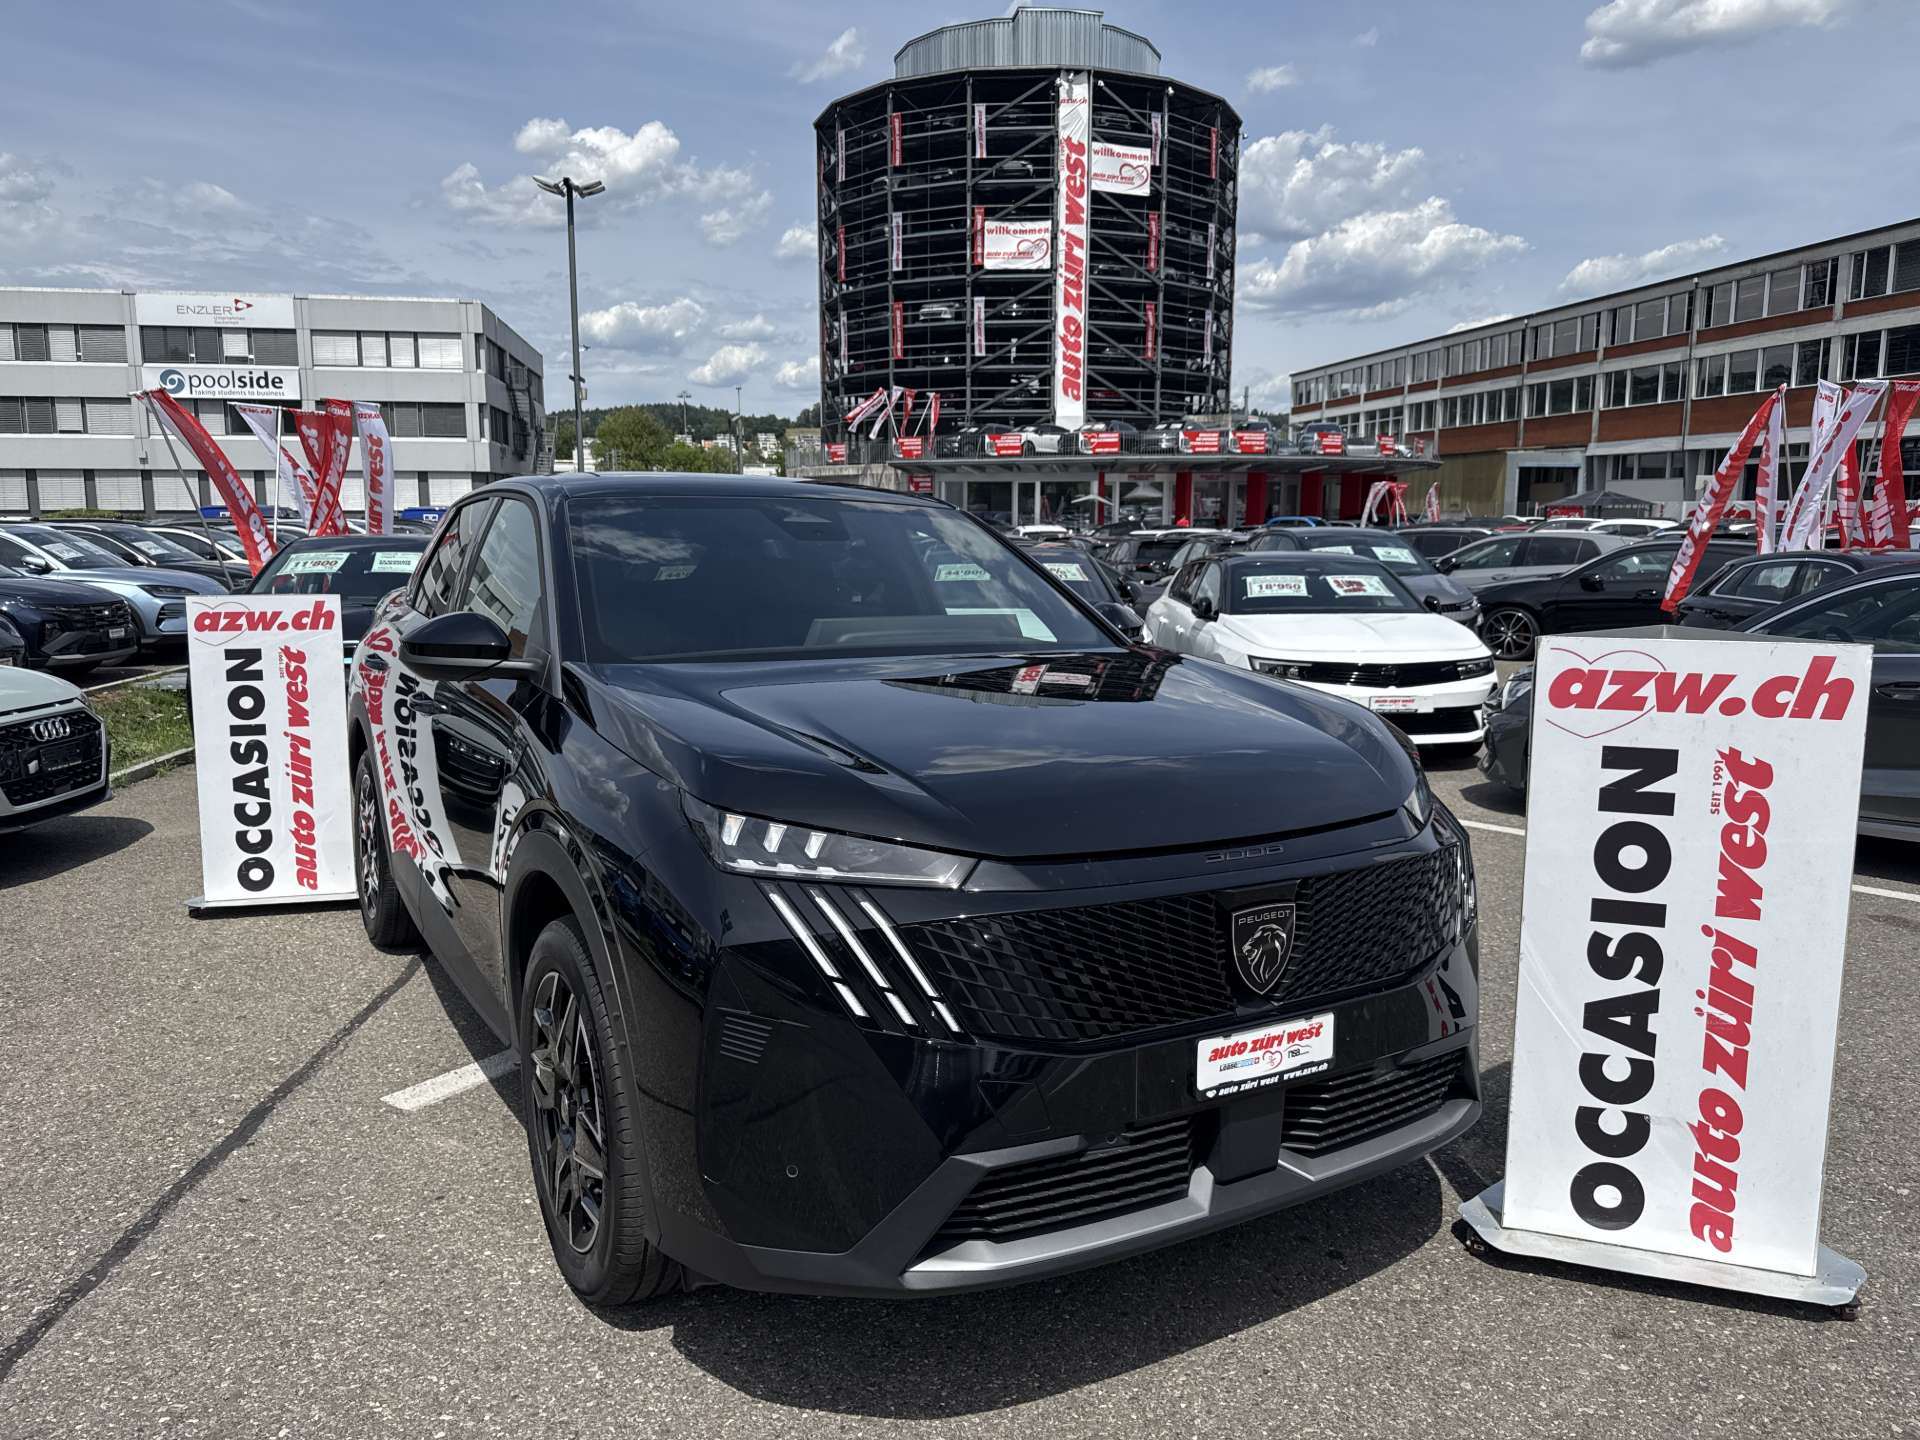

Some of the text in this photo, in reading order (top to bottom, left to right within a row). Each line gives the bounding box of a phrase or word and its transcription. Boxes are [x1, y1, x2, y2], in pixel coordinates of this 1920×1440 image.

[1093, 147, 1149, 161] willkommen
[986, 226, 1050, 236] willkommen
[1058, 135, 1086, 402] auto züri west
[176, 304, 232, 315] ENZLER
[188, 370, 283, 395] poolside
[366, 433, 384, 494] west
[1257, 583, 1301, 591] 18'950
[193, 600, 336, 632] azw.ch
[1548, 656, 1855, 721] azw.ch
[224, 648, 275, 892] OCCASION
[280, 645, 318, 891] auto züri west
[1710, 760, 1724, 815] SEIT 1991
[1238, 909, 1291, 925] PEUGEOT
[1570, 745, 1679, 1231] OCCASION
[1690, 746, 1775, 1254] auto züri west
[1208, 1023, 1323, 1062] auto züri west
[1218, 1086, 1239, 1096] auto
[1260, 1075, 1279, 1086] west
[1283, 1063, 1328, 1080] www.azw.ch
